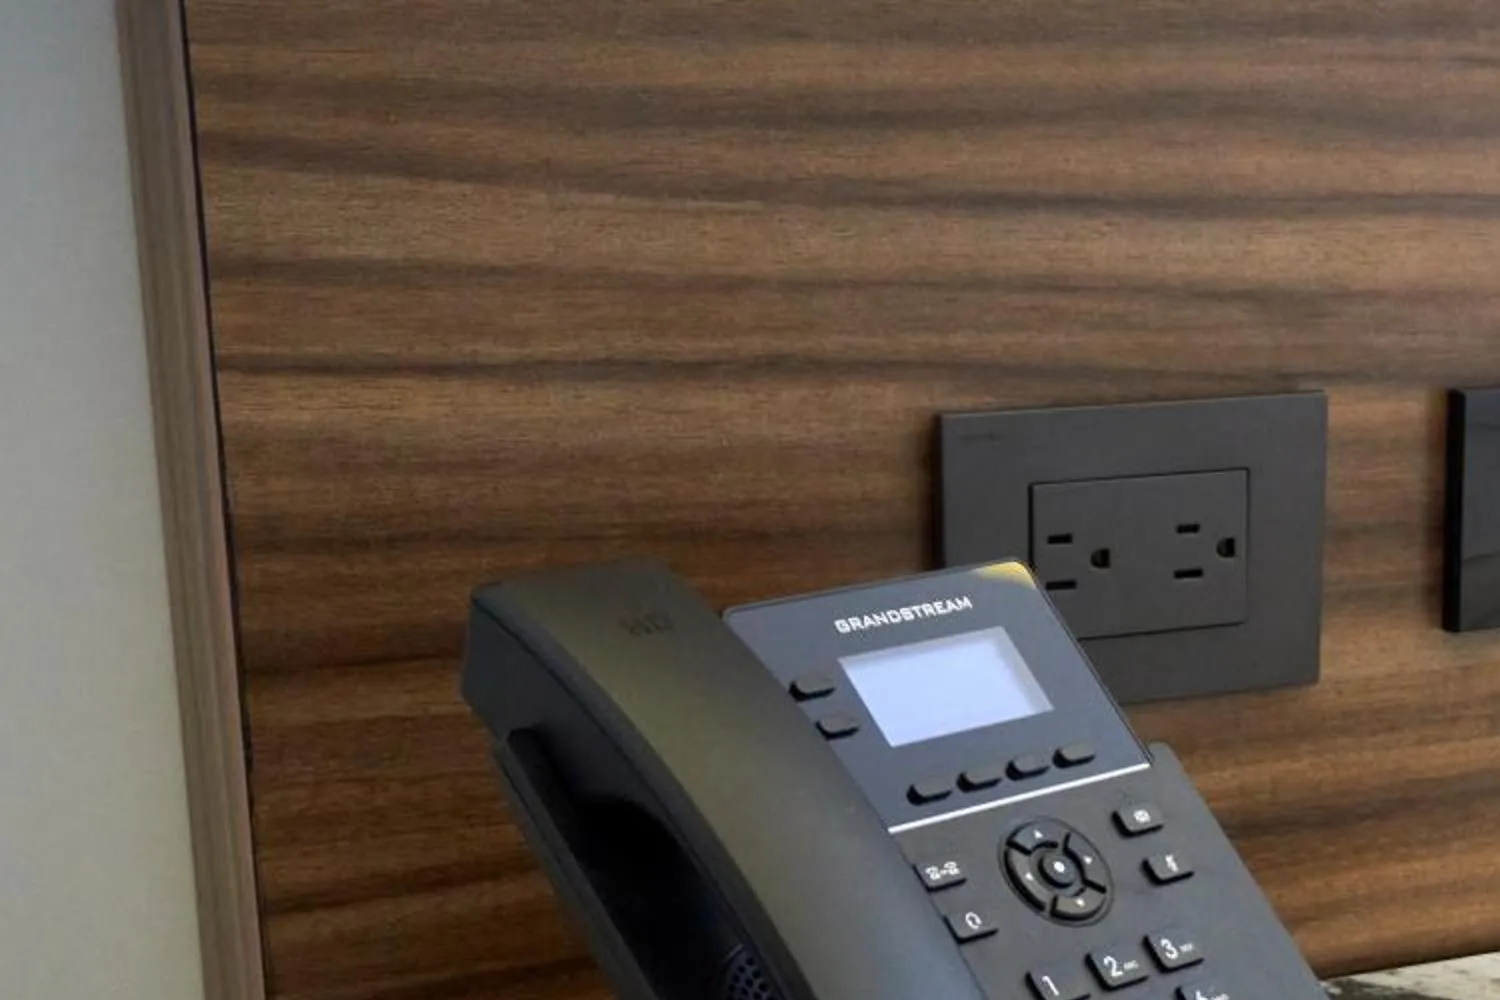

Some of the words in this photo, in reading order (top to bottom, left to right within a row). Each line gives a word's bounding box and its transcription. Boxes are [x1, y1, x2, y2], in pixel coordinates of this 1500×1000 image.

[834, 596, 973, 634] GRANDSTREAM
[1160, 938, 1178, 960] 3
[1103, 955, 1124, 977] 2
[1042, 975, 1060, 996] 1
